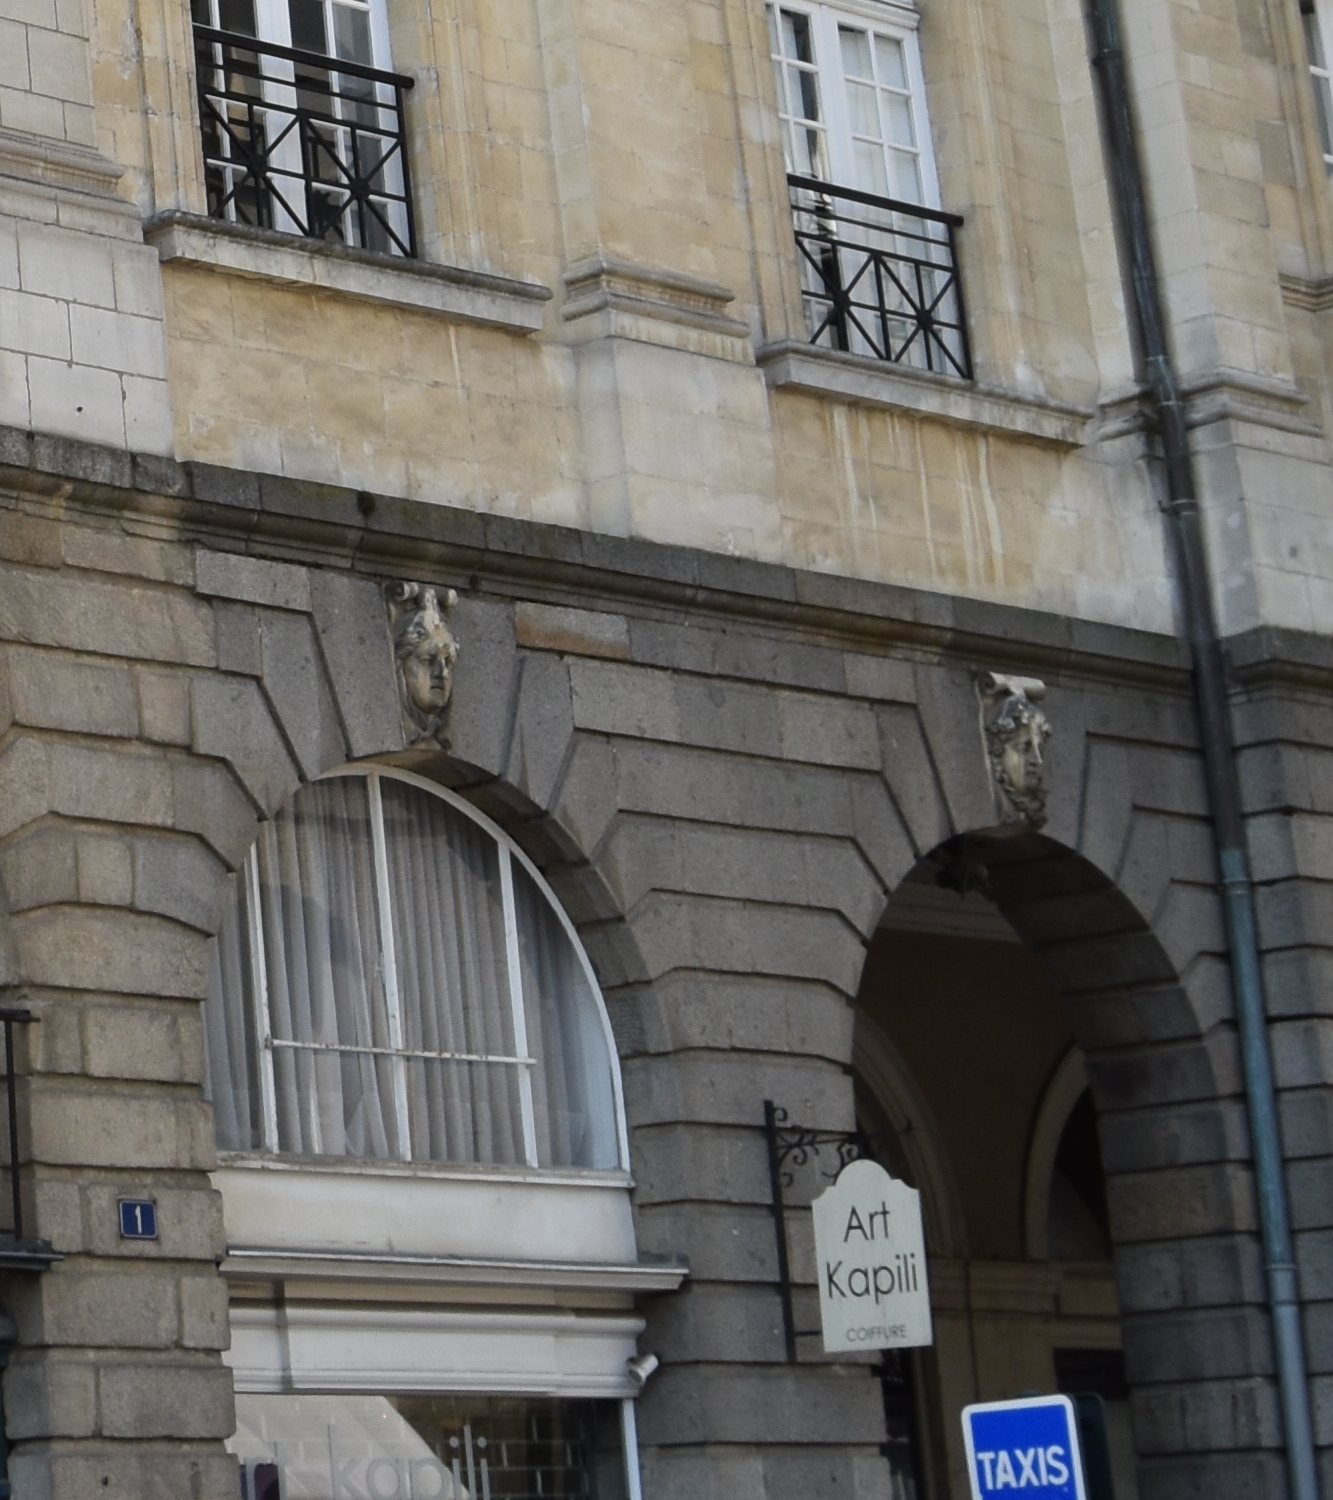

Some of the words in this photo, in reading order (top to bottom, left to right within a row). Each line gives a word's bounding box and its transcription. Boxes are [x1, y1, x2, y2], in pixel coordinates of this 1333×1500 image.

[134, 1204, 143, 1235] 1
[843, 1201, 890, 1242] Art
[826, 1252, 918, 1304] Kapili
[845, 1324, 907, 1342] COIFFURE
[976, 1444, 1070, 1490] TAXIS
